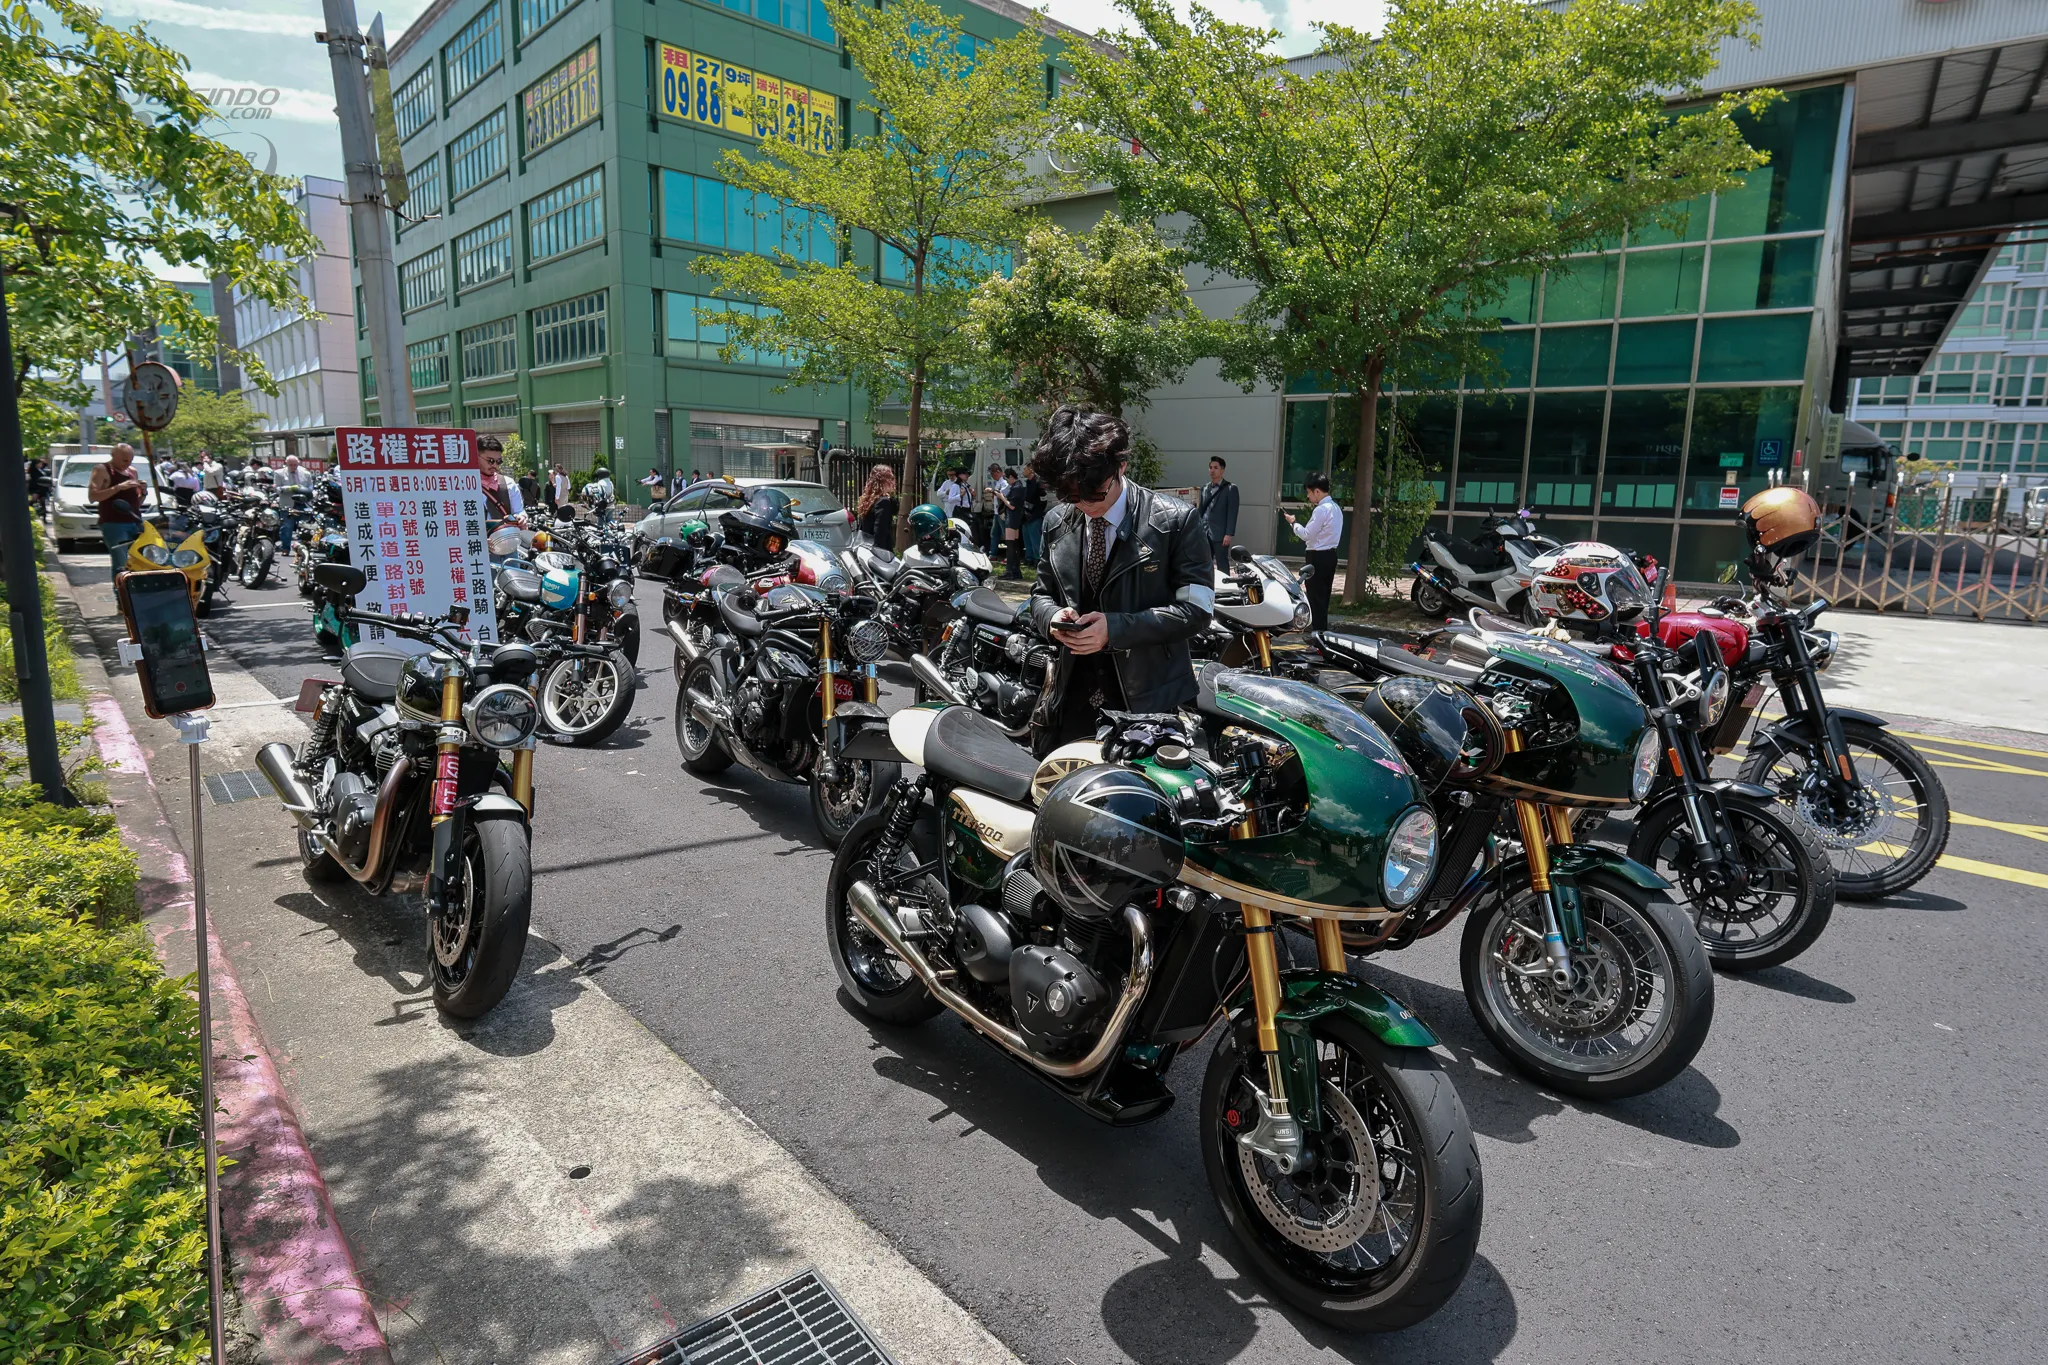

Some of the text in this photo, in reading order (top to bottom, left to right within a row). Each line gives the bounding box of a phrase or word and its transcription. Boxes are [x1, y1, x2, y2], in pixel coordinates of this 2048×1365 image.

[663, 47, 689, 69] 租
[346, 433, 470, 465] 路權活動
[422, 500, 439, 538] 部份
[354, 502, 379, 582] 造成不便
